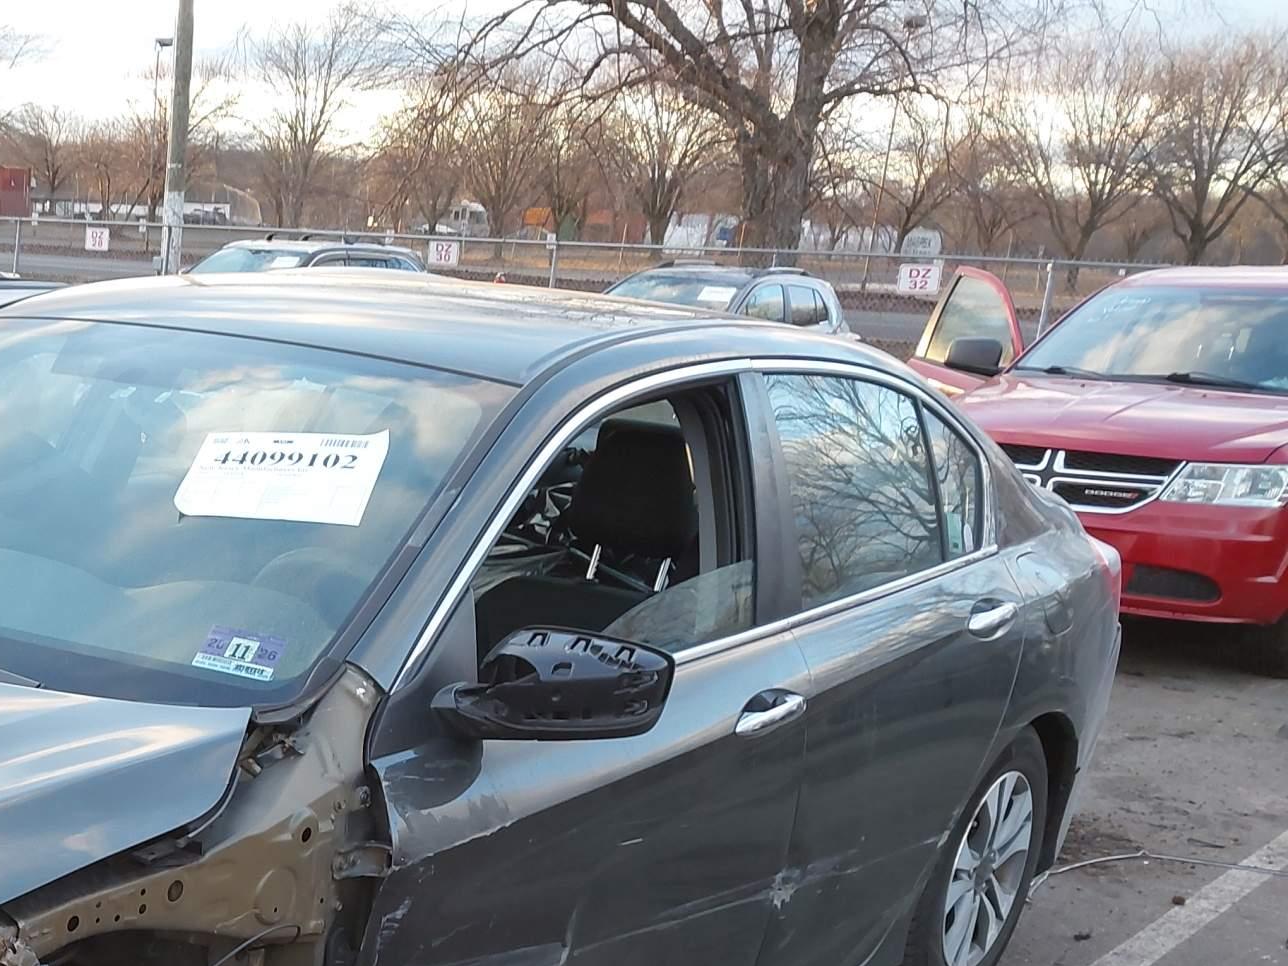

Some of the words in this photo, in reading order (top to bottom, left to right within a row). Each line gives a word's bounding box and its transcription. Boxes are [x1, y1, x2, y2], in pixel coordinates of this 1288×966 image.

[435, 242, 452, 252] DZ
[908, 268, 931, 278] DZ
[908, 279, 928, 290] 32
[213, 450, 358, 469] 44099102
[1084, 488, 1129, 498] DODGE
[228, 642, 251, 660] 11
